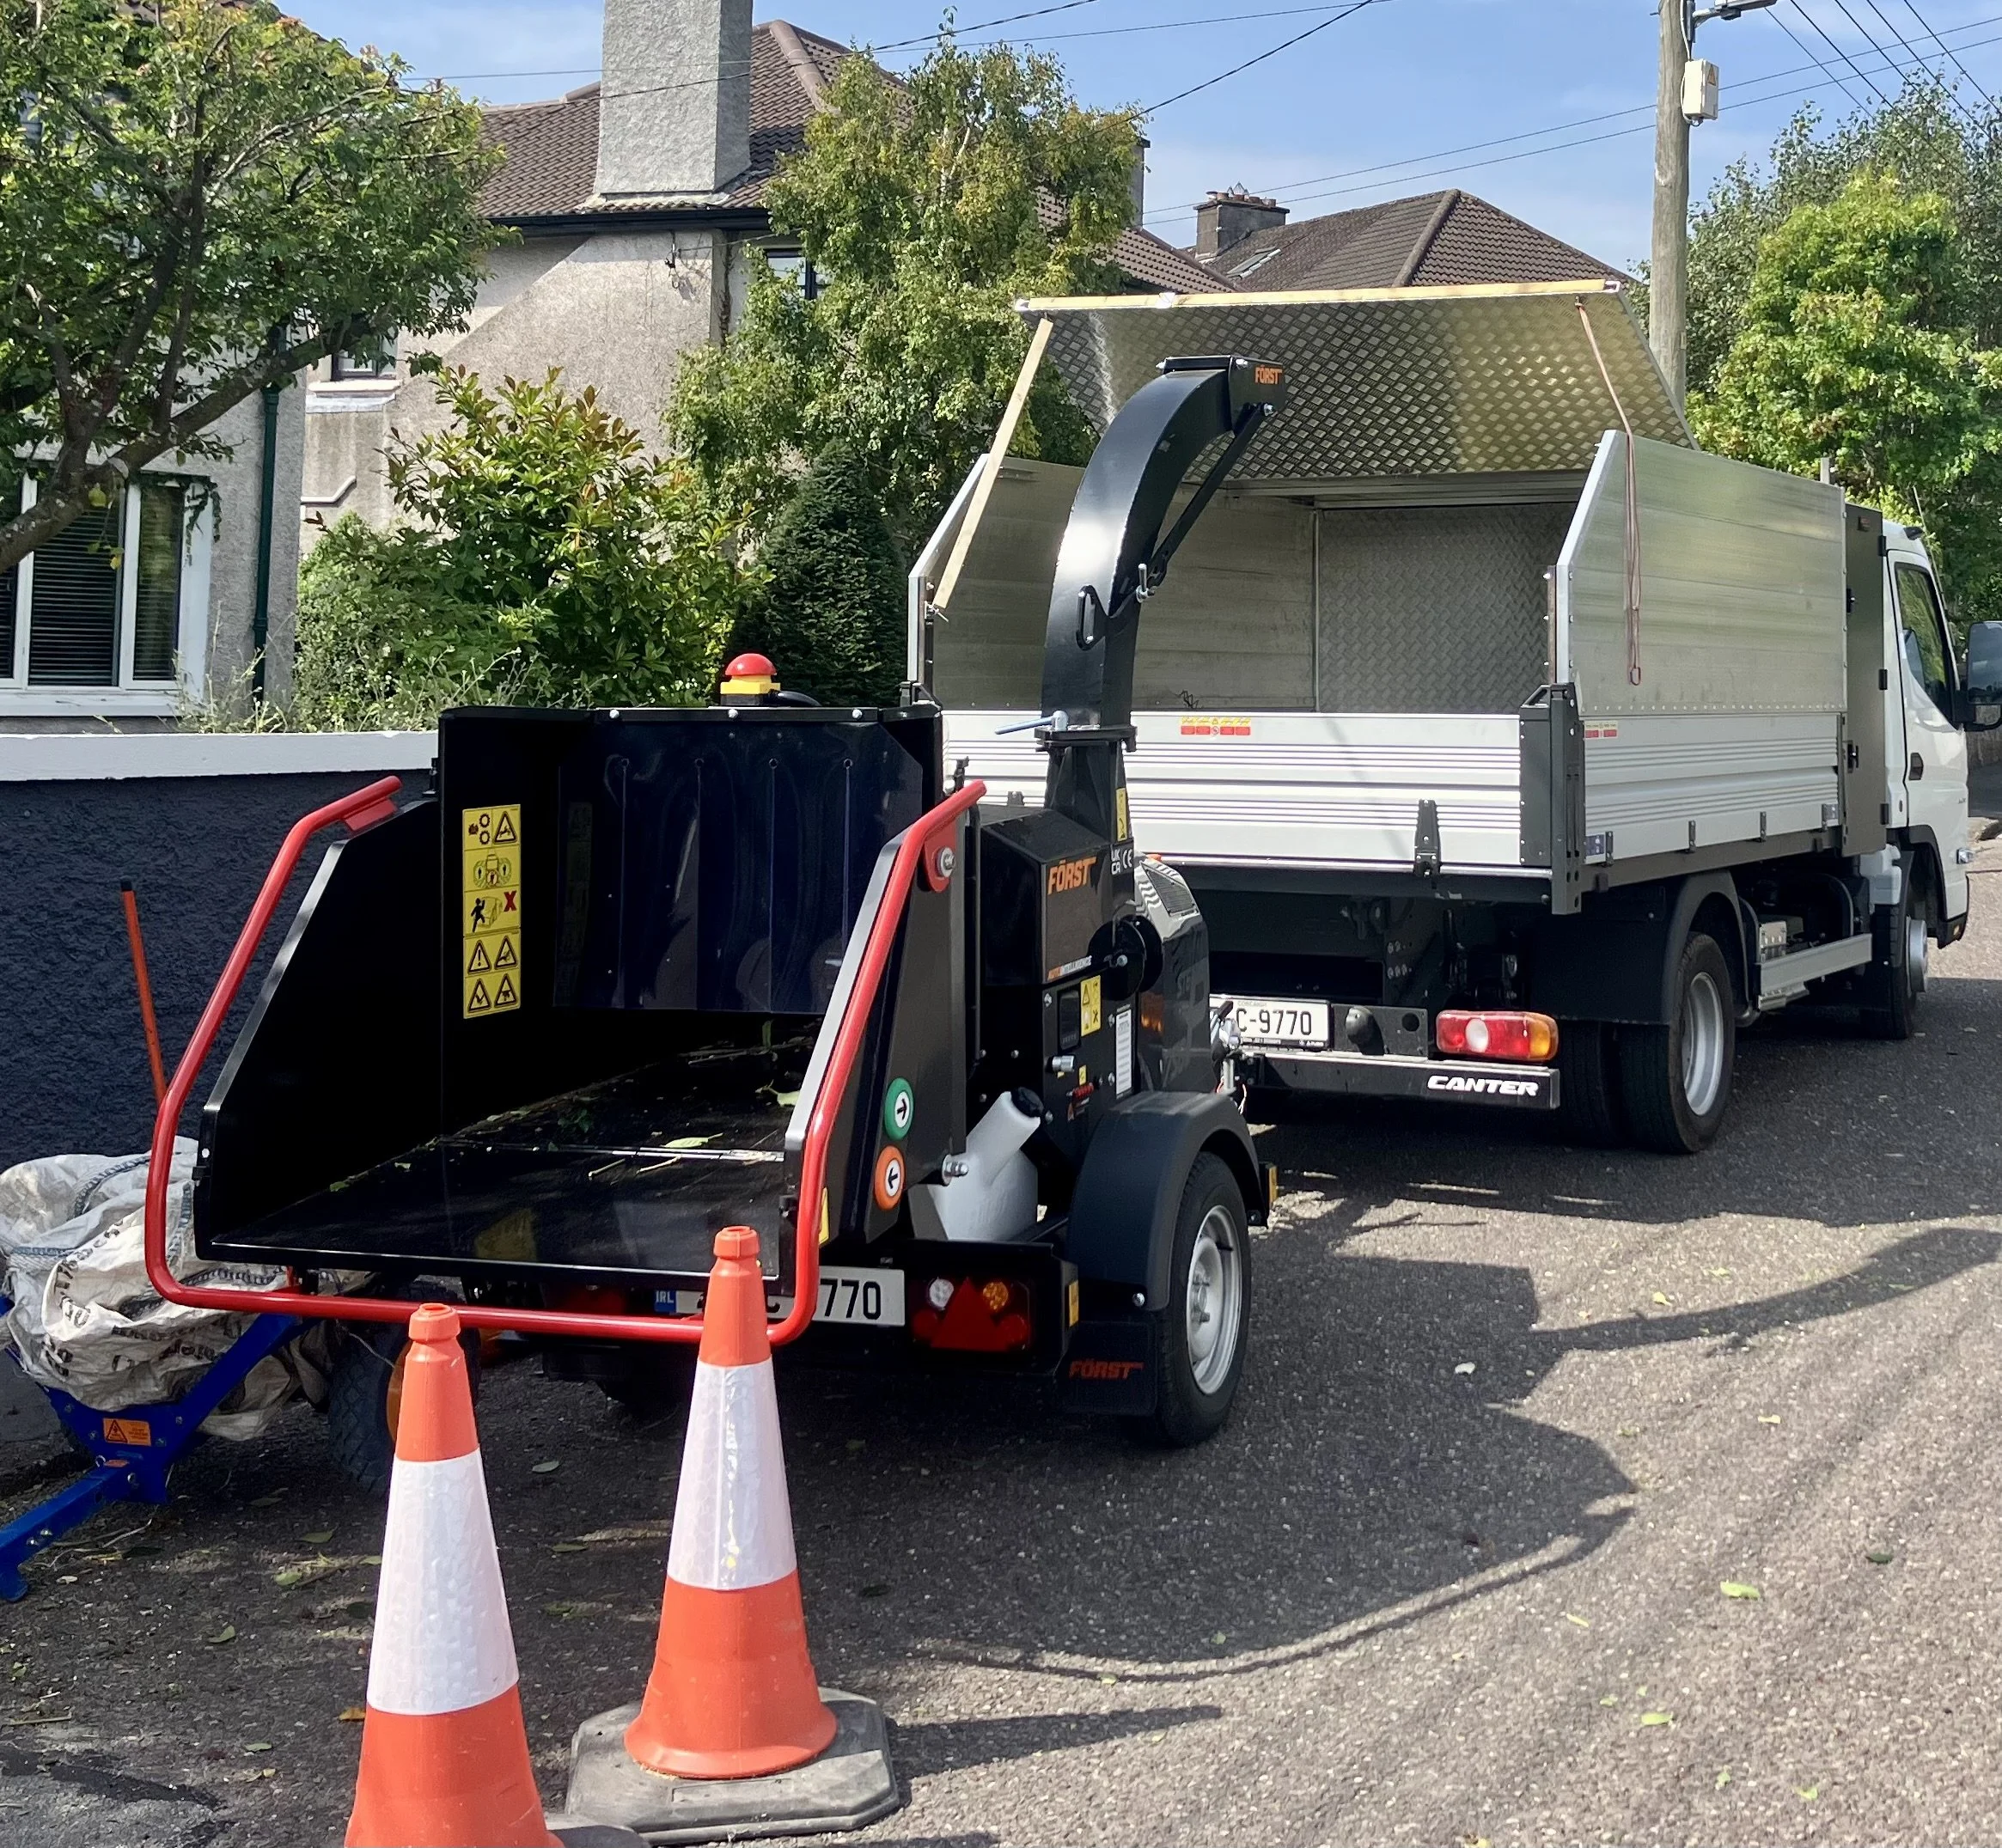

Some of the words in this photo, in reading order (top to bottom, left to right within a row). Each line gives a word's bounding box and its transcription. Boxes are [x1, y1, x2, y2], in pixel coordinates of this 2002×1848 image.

[1047, 856, 1096, 894] FÖRST
[1427, 1075, 1539, 1096] CANTER
[656, 1290, 674, 1303] IRL
